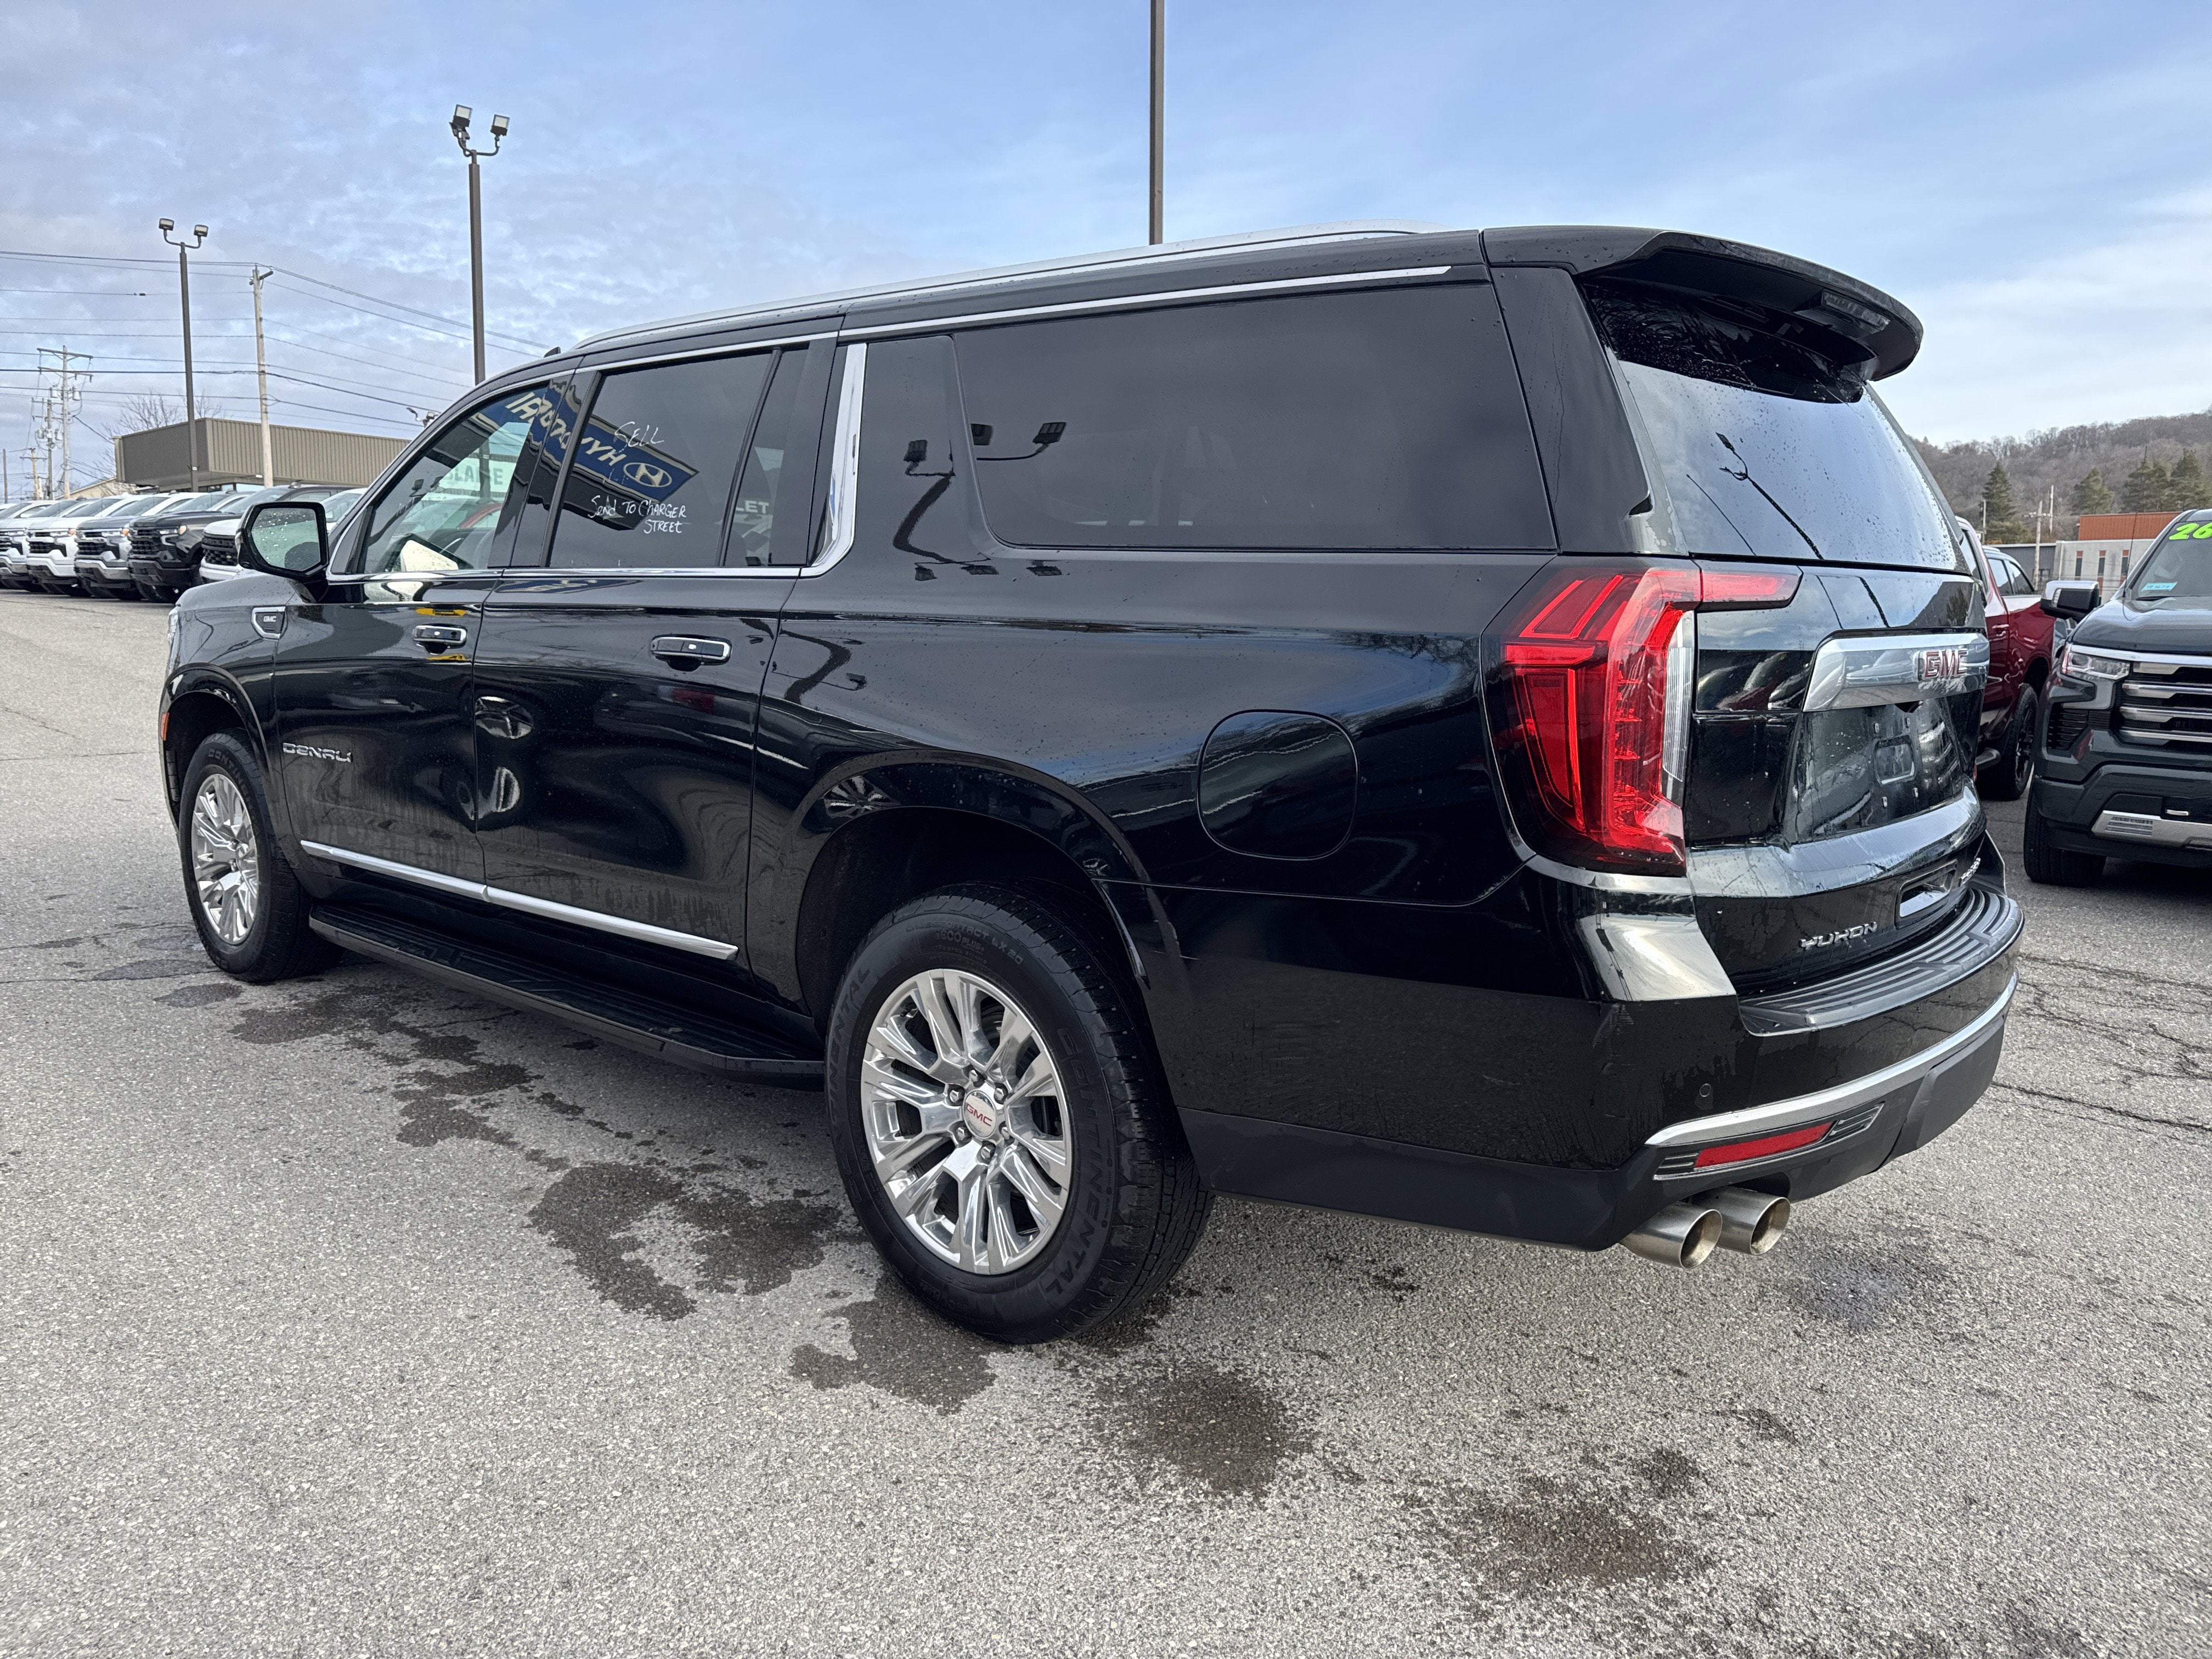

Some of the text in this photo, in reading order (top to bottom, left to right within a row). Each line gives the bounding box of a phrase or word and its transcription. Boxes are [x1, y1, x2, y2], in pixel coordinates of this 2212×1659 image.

[1923, 648, 1968, 679] GMC
[283, 742, 352, 763] DENALI
[1799, 921, 1878, 950] YUKON
[966, 1103, 993, 1127] GMC
[1045, 1029, 1103, 1295] CONTINENTAL
